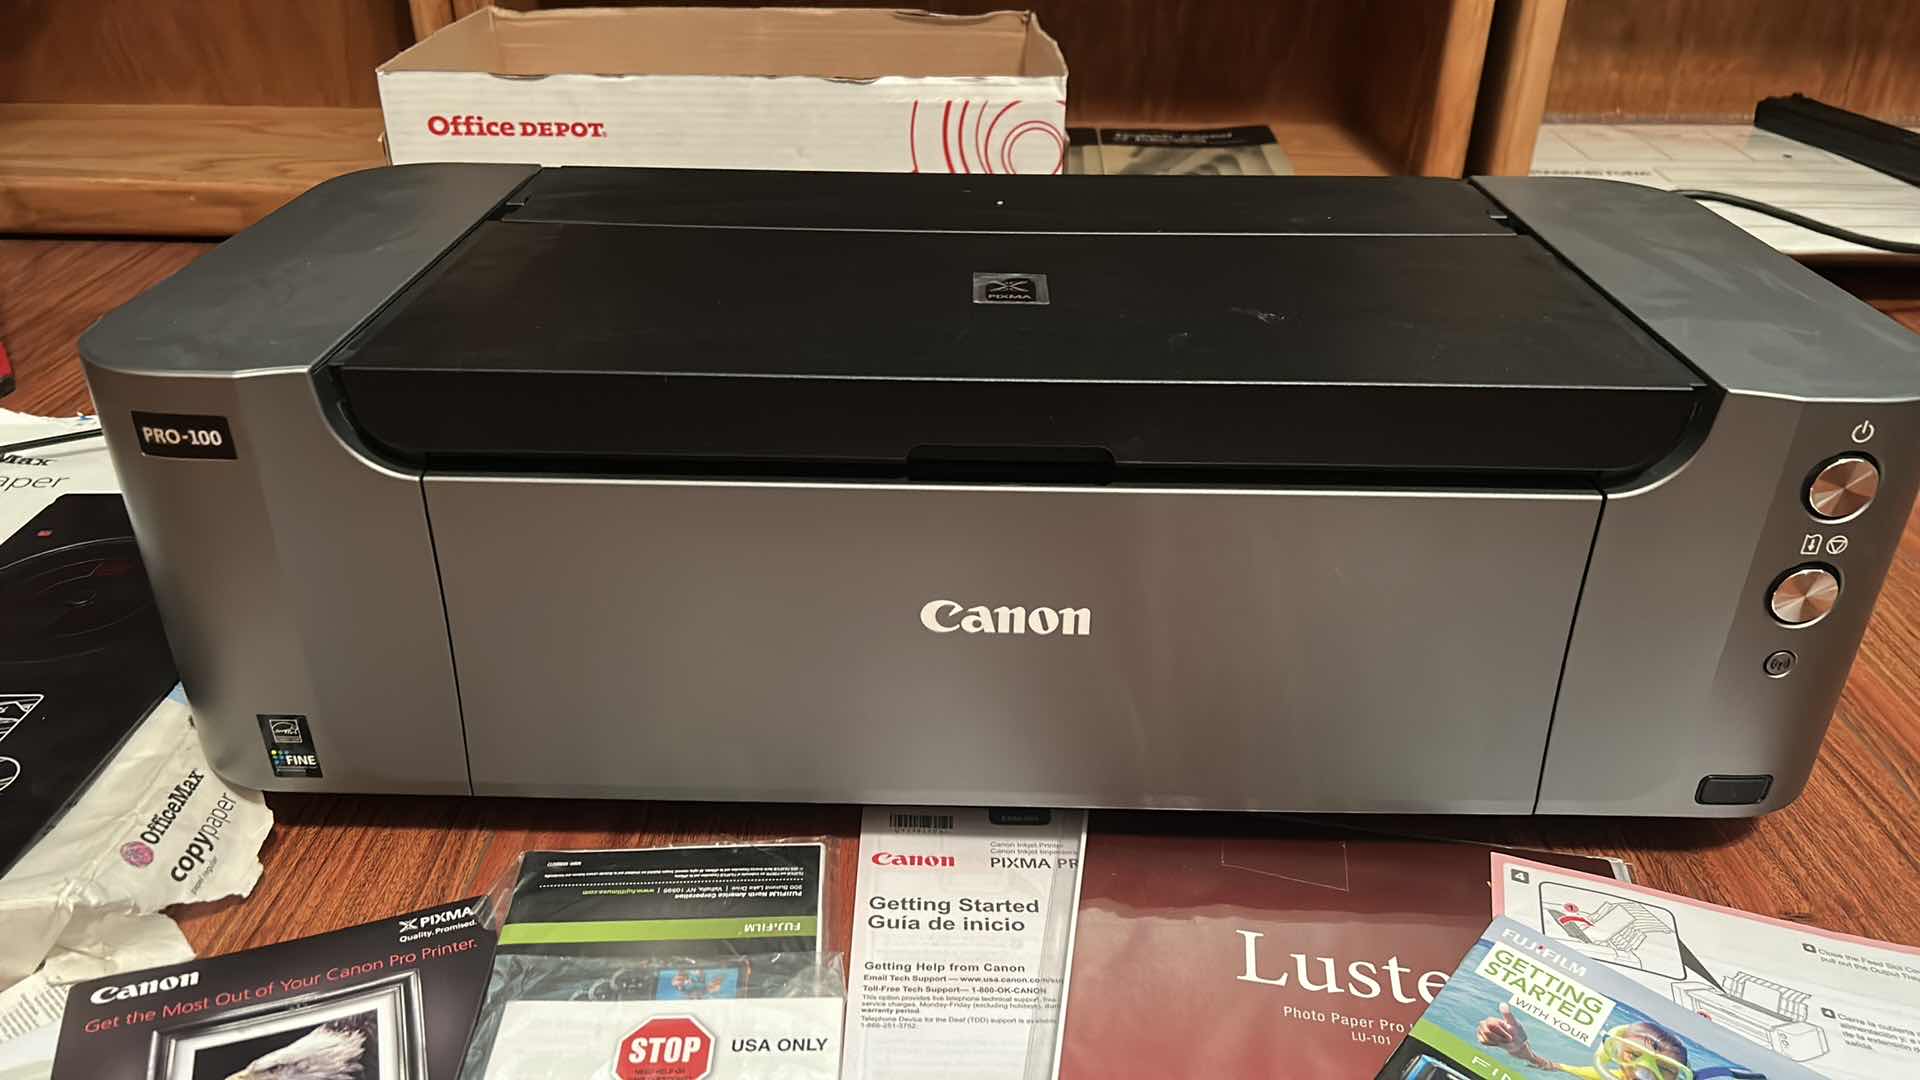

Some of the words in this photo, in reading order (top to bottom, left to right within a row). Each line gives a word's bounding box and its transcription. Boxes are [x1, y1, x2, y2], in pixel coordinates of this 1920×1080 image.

[427, 115, 515, 136] Office
[519, 122, 604, 137] DEPOT
[142, 426, 223, 446] PRO-100
[920, 599, 1091, 636] Canon
[285, 754, 317, 766] FINE
[140, 768, 205, 845] OfficeMax
[871, 852, 956, 867] Canon
[990, 857, 1052, 869] PIXMA
[1514, 871, 1526, 881] 4
[869, 896, 951, 914] Getting
[959, 897, 1039, 913] Started
[420, 906, 475, 928] PIXMA
[744, 921, 801, 933] FUJIFILM
[868, 914, 921, 930] Guía
[928, 916, 956, 931] de
[963, 916, 1025, 932] inicio
[399, 931, 434, 943] Quality.
[435, 919, 478, 934] Promised.
[864, 961, 912, 973] Getting
[916, 961, 945, 973] Help
[949, 962, 980, 972] from
[983, 962, 1026, 973] Canon
[84, 1017, 118, 1033] Get
[126, 1009, 156, 1026] the
[163, 997, 210, 1018] Most
[215, 989, 250, 1007] Out
[255, 981, 274, 999] of
[280, 973, 321, 993] Your
[326, 961, 385, 983] Canon
[389, 952, 417, 967] Pro
[421, 938, 478, 960] Printer.
[90, 971, 199, 1005] Canon
[912, 975, 947, 983] Support
[1494, 949, 1604, 1014] GETTING
[863, 984, 900, 992] Toll-Free
[903, 985, 923, 993] Tech
[972, 986, 1047, 995] 1-800-OK-CANON
[1484, 961, 1595, 1026] STARTED
[1283, 1005, 1326, 1023] Photo
[1331, 1012, 1374, 1030] Paper
[1380, 1018, 1405, 1033] Pro
[1515, 996, 1550, 1020] WITH
[1553, 1017, 1589, 1042] YOUR
[732, 1038, 771, 1052] USA
[777, 1038, 829, 1051] ONLY
[1352, 1031, 1392, 1046] LU-101
[628, 1036, 702, 1065] STOP
